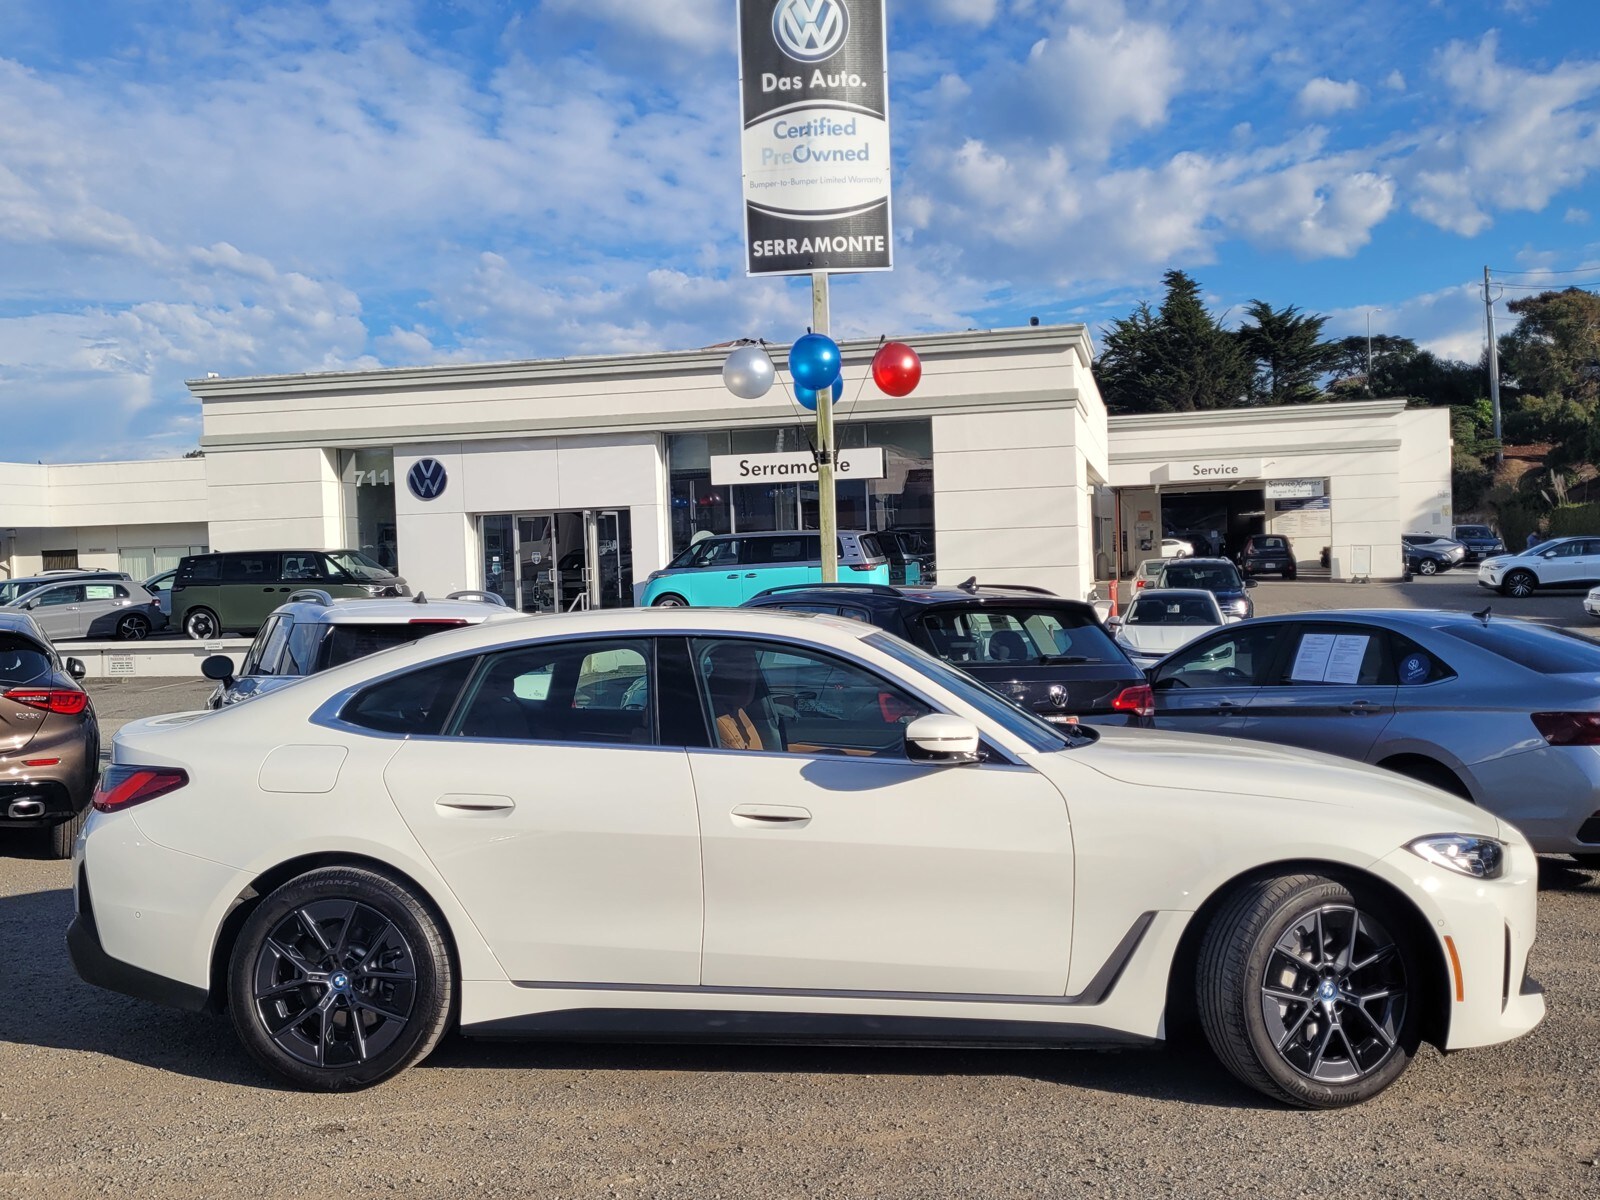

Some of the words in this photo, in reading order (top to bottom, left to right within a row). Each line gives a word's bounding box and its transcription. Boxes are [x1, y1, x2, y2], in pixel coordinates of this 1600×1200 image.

[762, 72, 803, 92] Das
[809, 69, 867, 88] Auto.
[773, 117, 856, 139] Certified
[749, 177, 819, 188] Bumper-to-Bumper
[820, 176, 847, 185] Limited
[847, 175, 883, 185] Warranty
[753, 235, 885, 257] SERRAMONTE
[739, 459, 851, 477] Serramote
[1192, 464, 1239, 476] Service
[354, 469, 390, 488] 711
[300, 879, 360, 890] TURANZA
[1283, 1078, 1360, 1105] BRIDGESTONE
